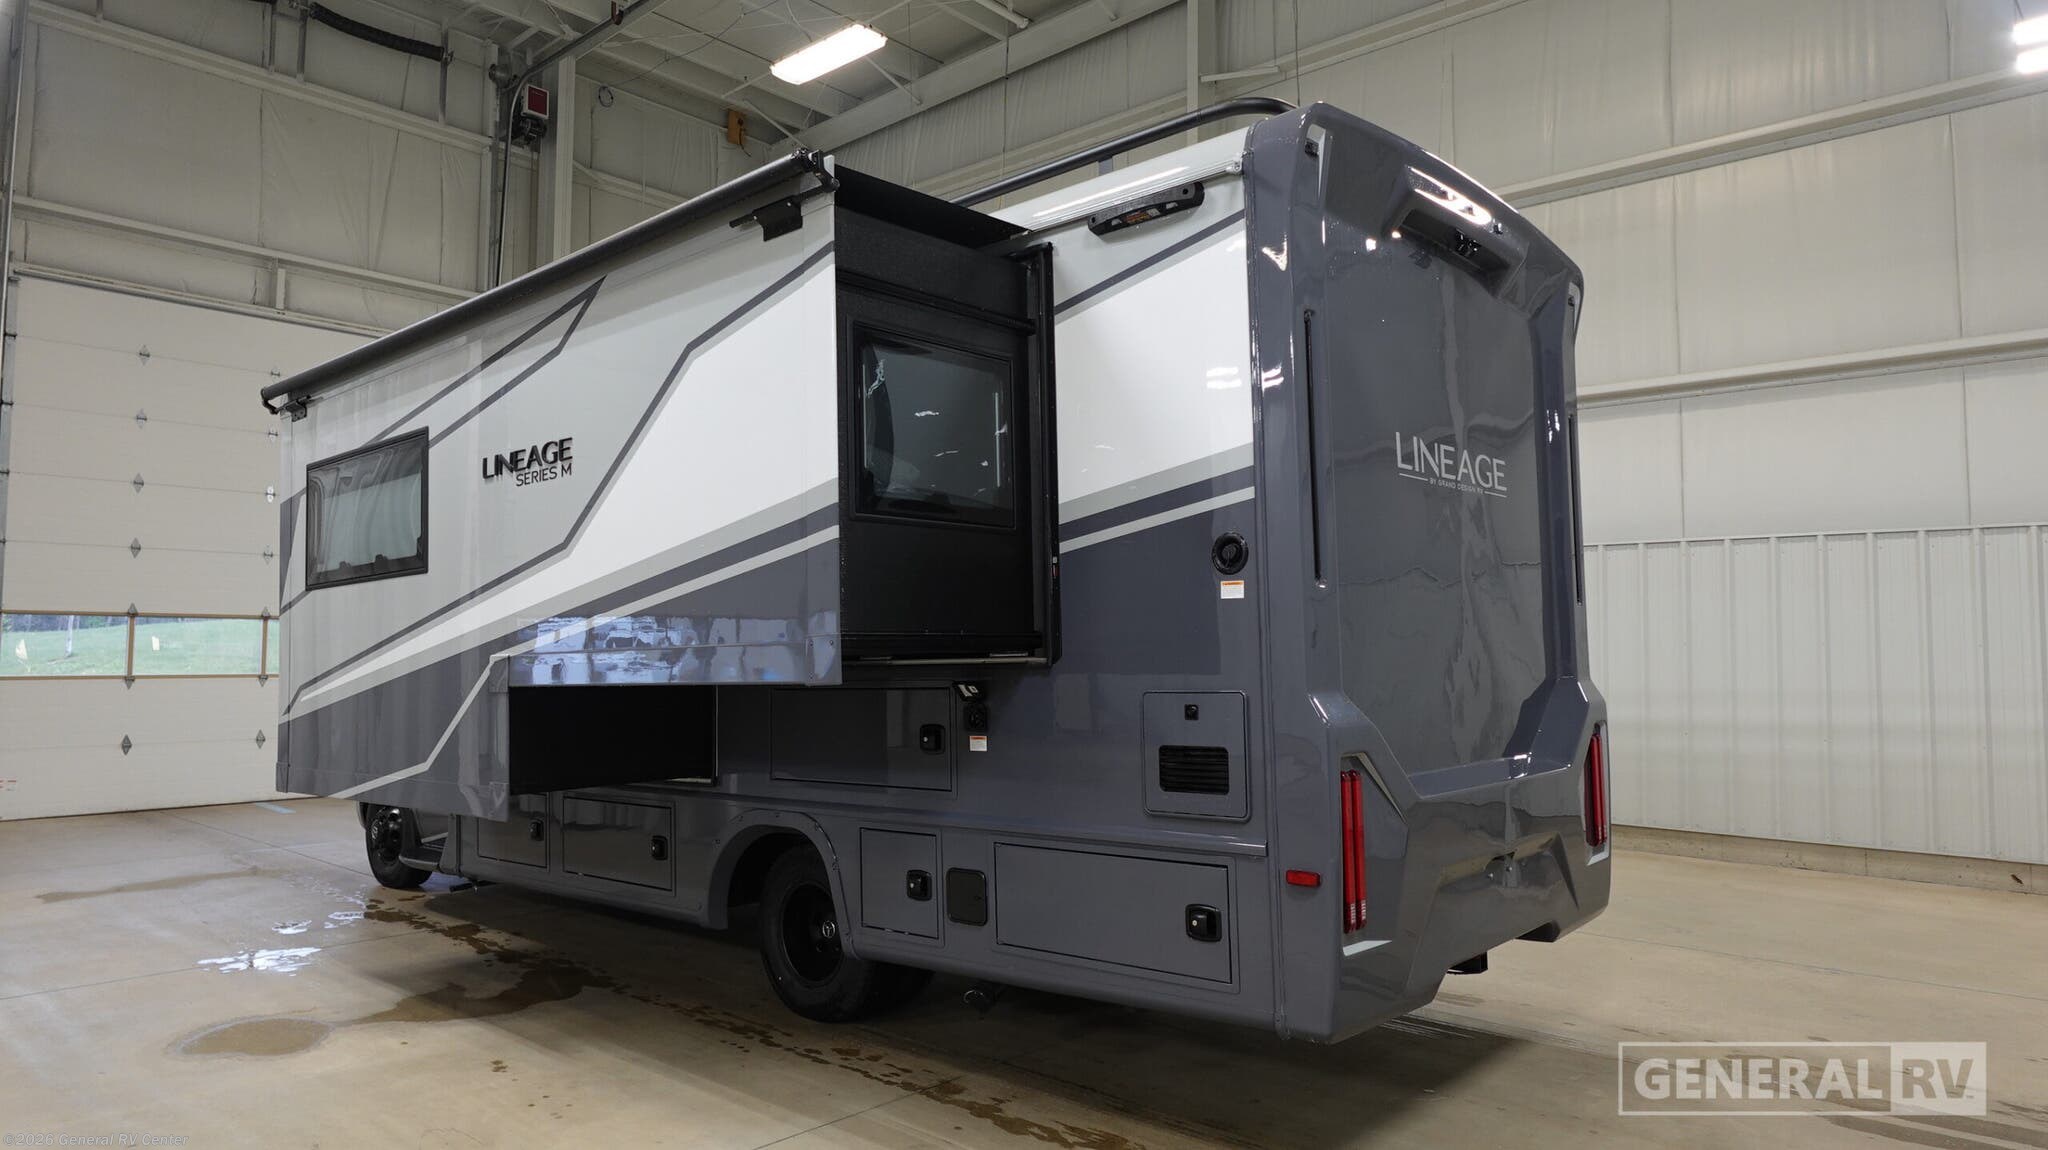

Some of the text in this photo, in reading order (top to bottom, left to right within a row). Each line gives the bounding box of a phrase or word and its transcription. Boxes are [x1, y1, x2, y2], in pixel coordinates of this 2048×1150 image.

[482, 437, 573, 480] LINEAGE
[516, 462, 572, 487] SERIES M
[1395, 432, 1507, 491] LINEAGE
